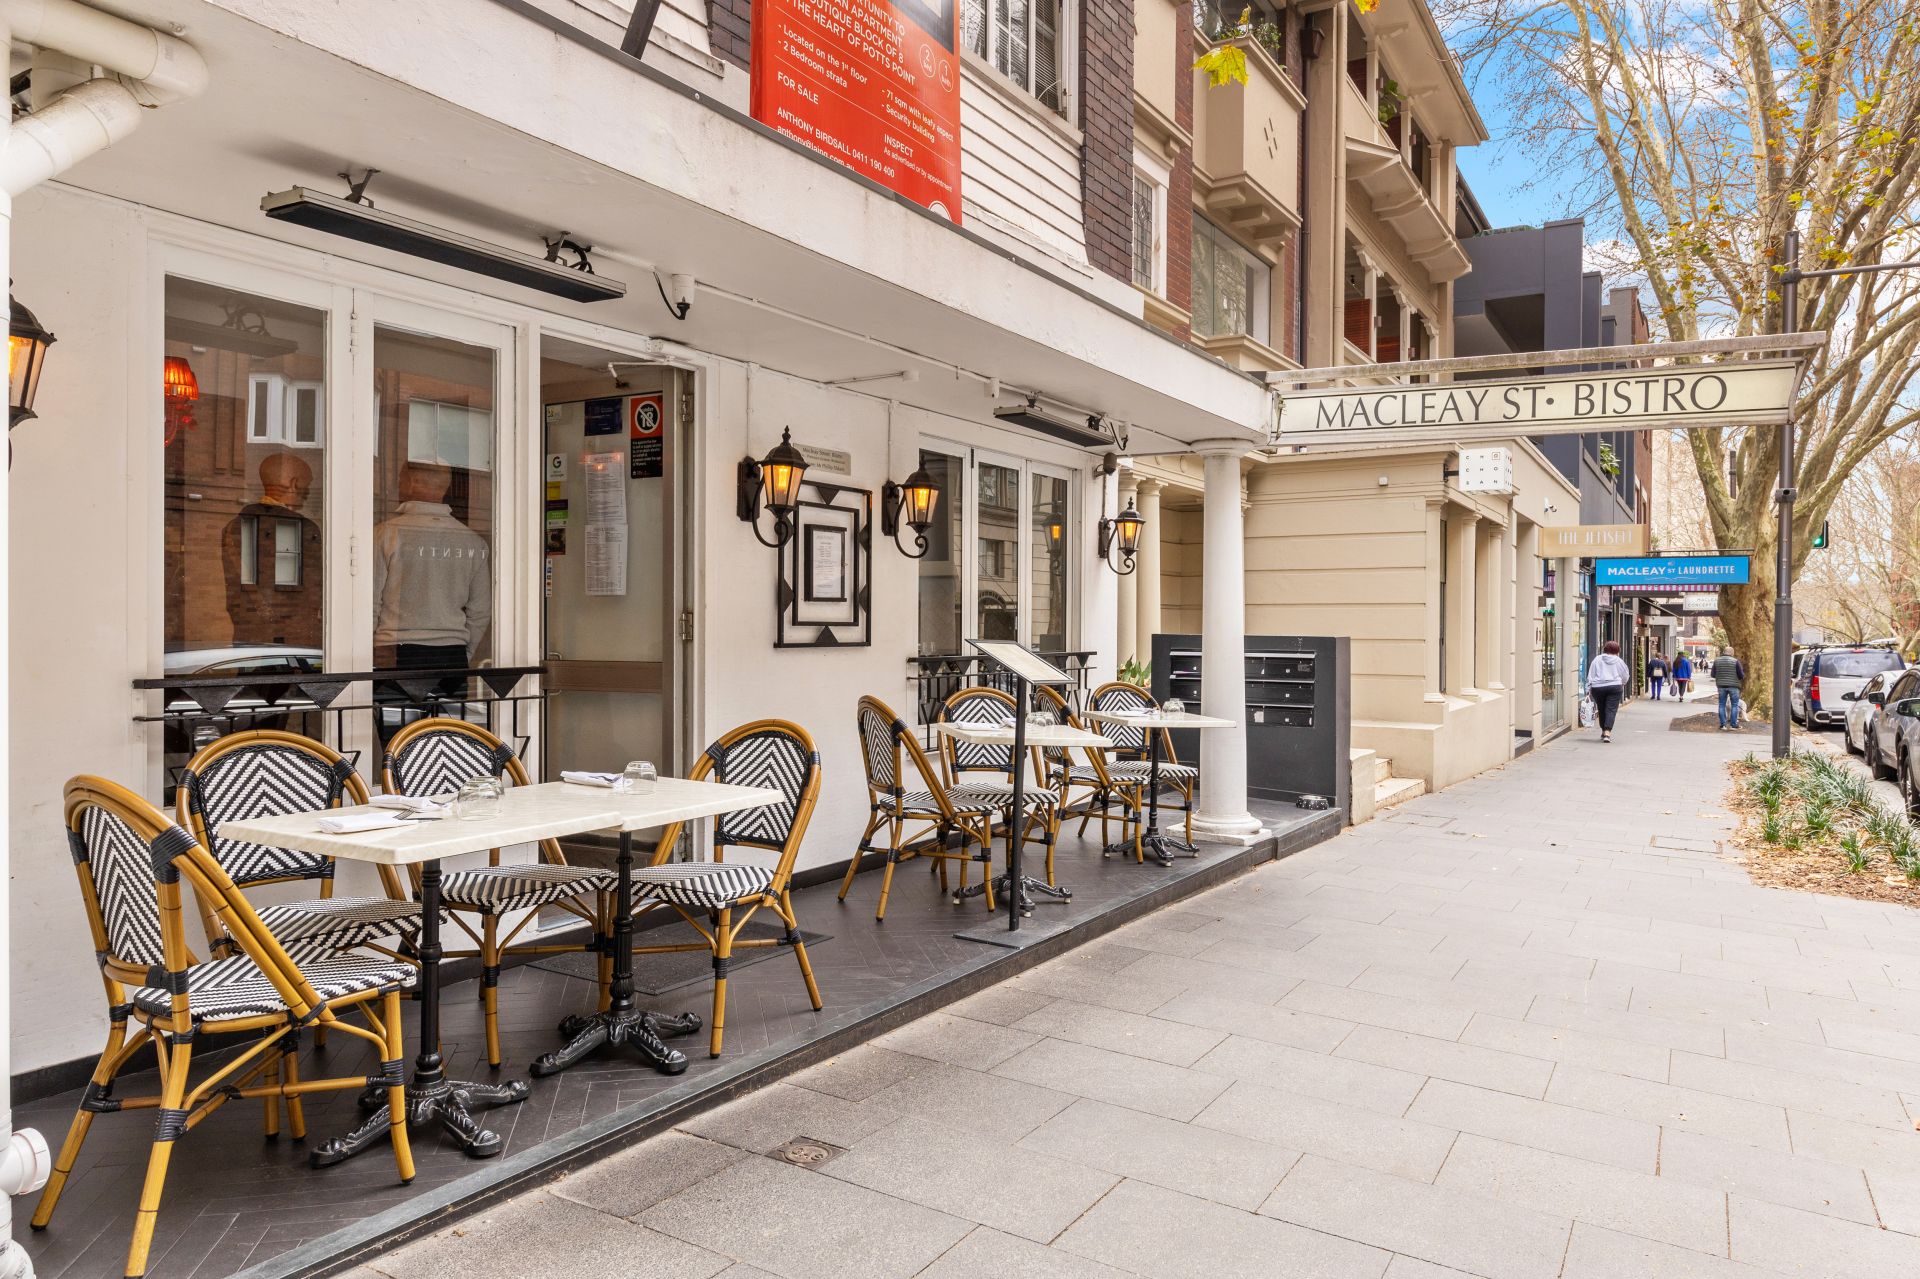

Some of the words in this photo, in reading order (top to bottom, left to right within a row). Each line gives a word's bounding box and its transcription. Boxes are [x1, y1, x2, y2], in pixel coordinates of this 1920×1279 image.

[793, 0, 811, 17] THE
[813, 10, 846, 38] HEART
[848, 33, 861, 48] OF
[862, 42, 890, 68] POTTS
[892, 62, 916, 86] POINT
[851, 4, 902, 48] APARTMENT
[854, 21, 884, 50] BLOCK
[886, 44, 897, 57] OF
[898, 52, 904, 64] 8
[894, 20, 905, 36] TO
[783, 24, 814, 52] Located
[816, 48, 826, 60] on
[827, 54, 840, 68] the
[850, 67, 868, 84] floor
[783, 40, 789, 52] 2
[790, 45, 825, 74] Bedroom
[826, 70, 848, 88] strata
[925, 49, 930, 61] 2
[777, 71, 796, 91] FOR
[797, 84, 819, 105] SALE
[886, 104, 912, 128] Security
[912, 120, 935, 144] building
[894, 96, 908, 110] sqm
[908, 105, 921, 120] with
[922, 113, 936, 130] leafy
[777, 107, 814, 135] ANTHONY
[816, 128, 852, 156] BIRDSALL
[852, 148, 868, 164] 0411
[870, 158, 882, 172] 190
[883, 166, 895, 178] 400
[884, 134, 914, 158] INSPECT
[884, 146, 891, 156] As
[892, 152, 916, 170] advertised
[1316, 390, 1488, 428] MACLEAY
[1574, 375, 1728, 416] BISTRO
[1607, 566, 1666, 576] MACLEAY
[1678, 566, 1735, 574] LAUNDRETTE
